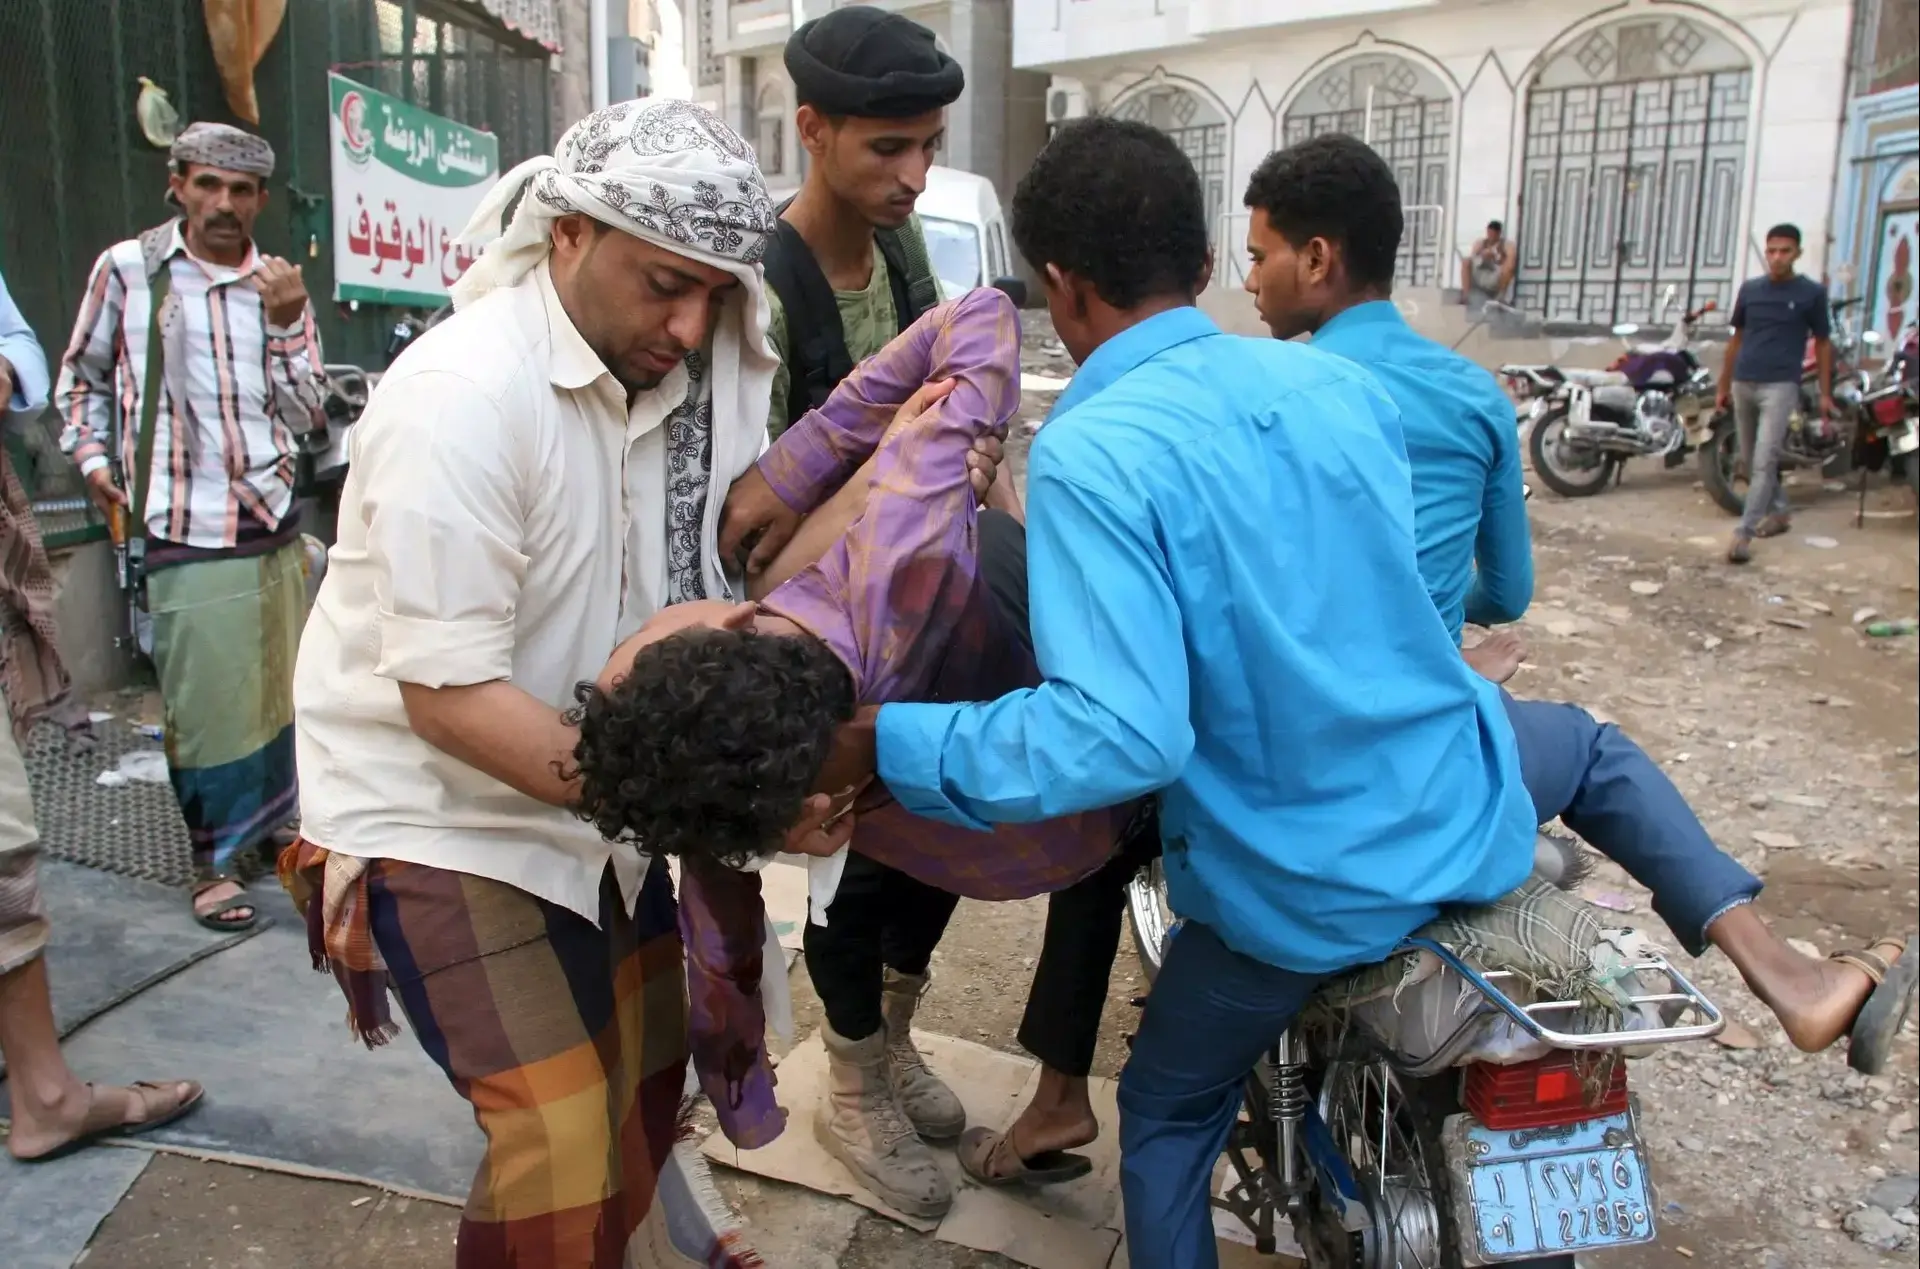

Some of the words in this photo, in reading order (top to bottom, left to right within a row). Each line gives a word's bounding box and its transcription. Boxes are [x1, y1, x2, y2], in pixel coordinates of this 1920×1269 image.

[381, 105, 435, 167] الروضة
[436, 132, 487, 176] مستشفى
[348, 193, 434, 278] الوقوف
[1558, 1200, 1633, 1243] 2795
